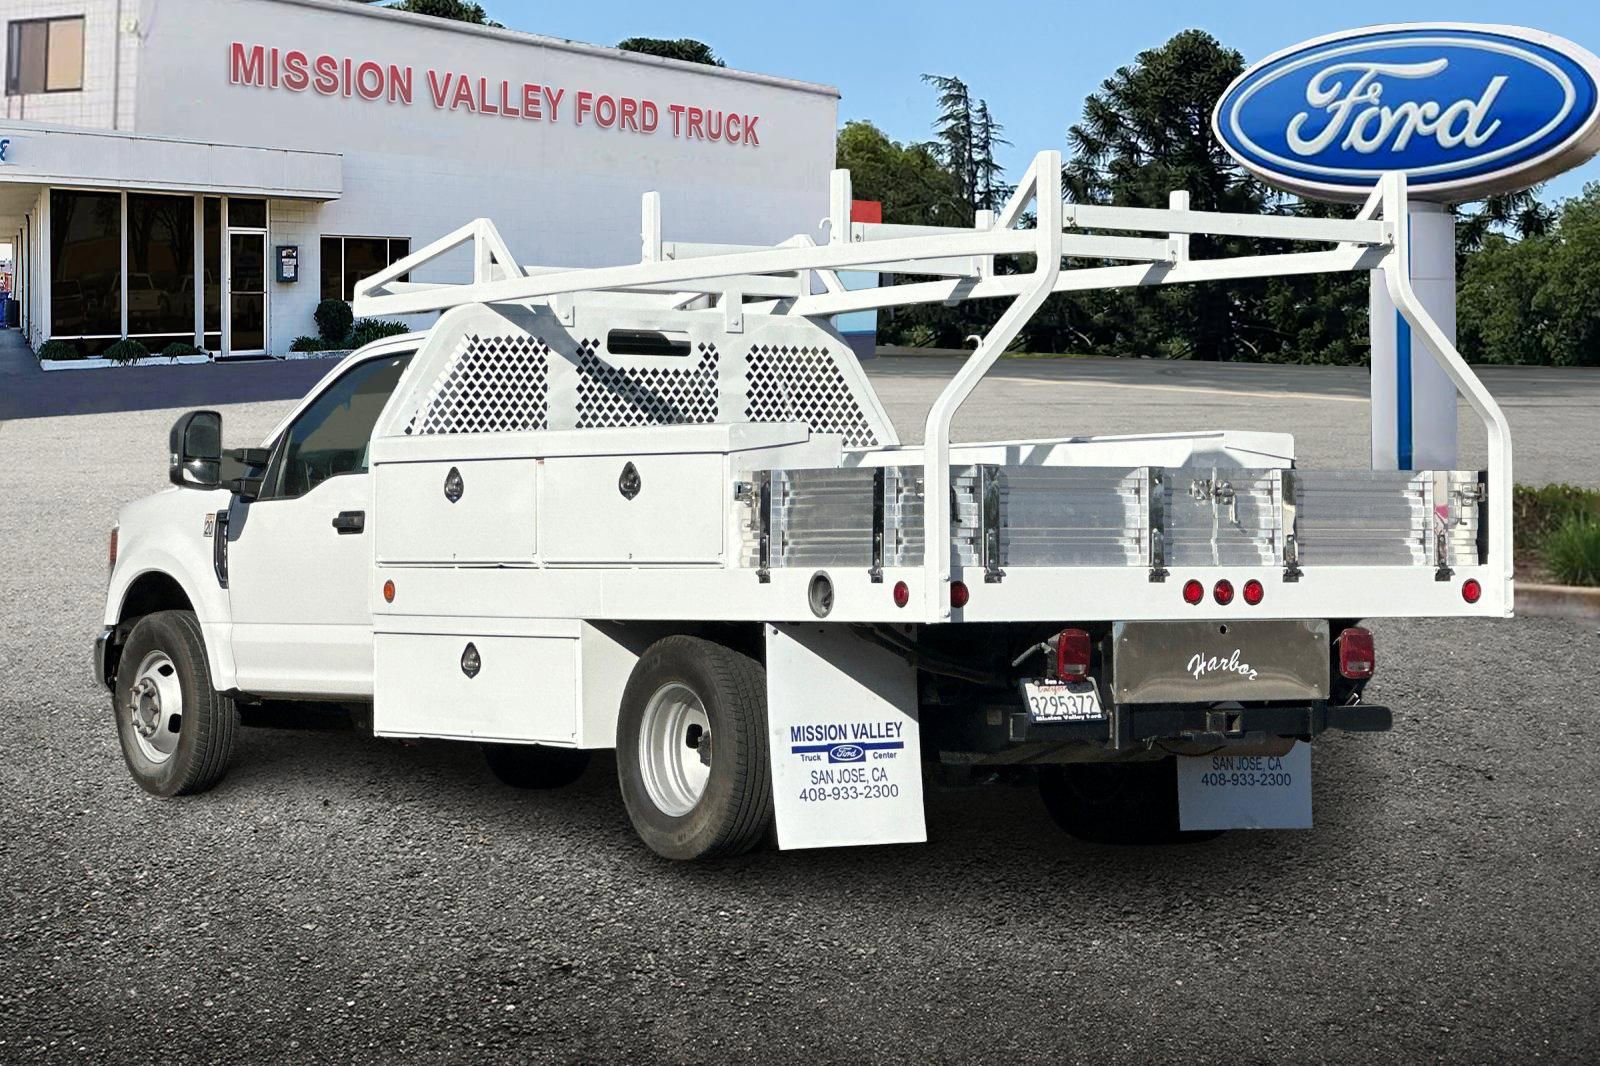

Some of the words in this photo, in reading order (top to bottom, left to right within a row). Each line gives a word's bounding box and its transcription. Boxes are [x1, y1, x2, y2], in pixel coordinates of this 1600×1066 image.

[230, 42, 414, 105] MISSION
[427, 69, 565, 122] VALLEY
[576, 91, 660, 133] FORD
[669, 104, 761, 146] TRUCK
[1286, 57, 1510, 156] Ford
[1187, 649, 1258, 680] Harbor
[791, 724, 847, 742] MISSION
[851, 722, 902, 740] VALLEY
[800, 753, 822, 762] Truck
[836, 747, 857, 758] Ford
[872, 751, 897, 760] Center
[1212, 757, 1234, 771] SAN
[1236, 757, 1265, 772] JOSE,
[1267, 756, 1283, 771] CA
[810, 769, 834, 785] SAN
[836, 768, 869, 784] JOSE,
[871, 767, 889, 782] CA
[1201, 773, 1292, 787] 408-933-2300
[799, 784, 899, 802] 408-933-2300
